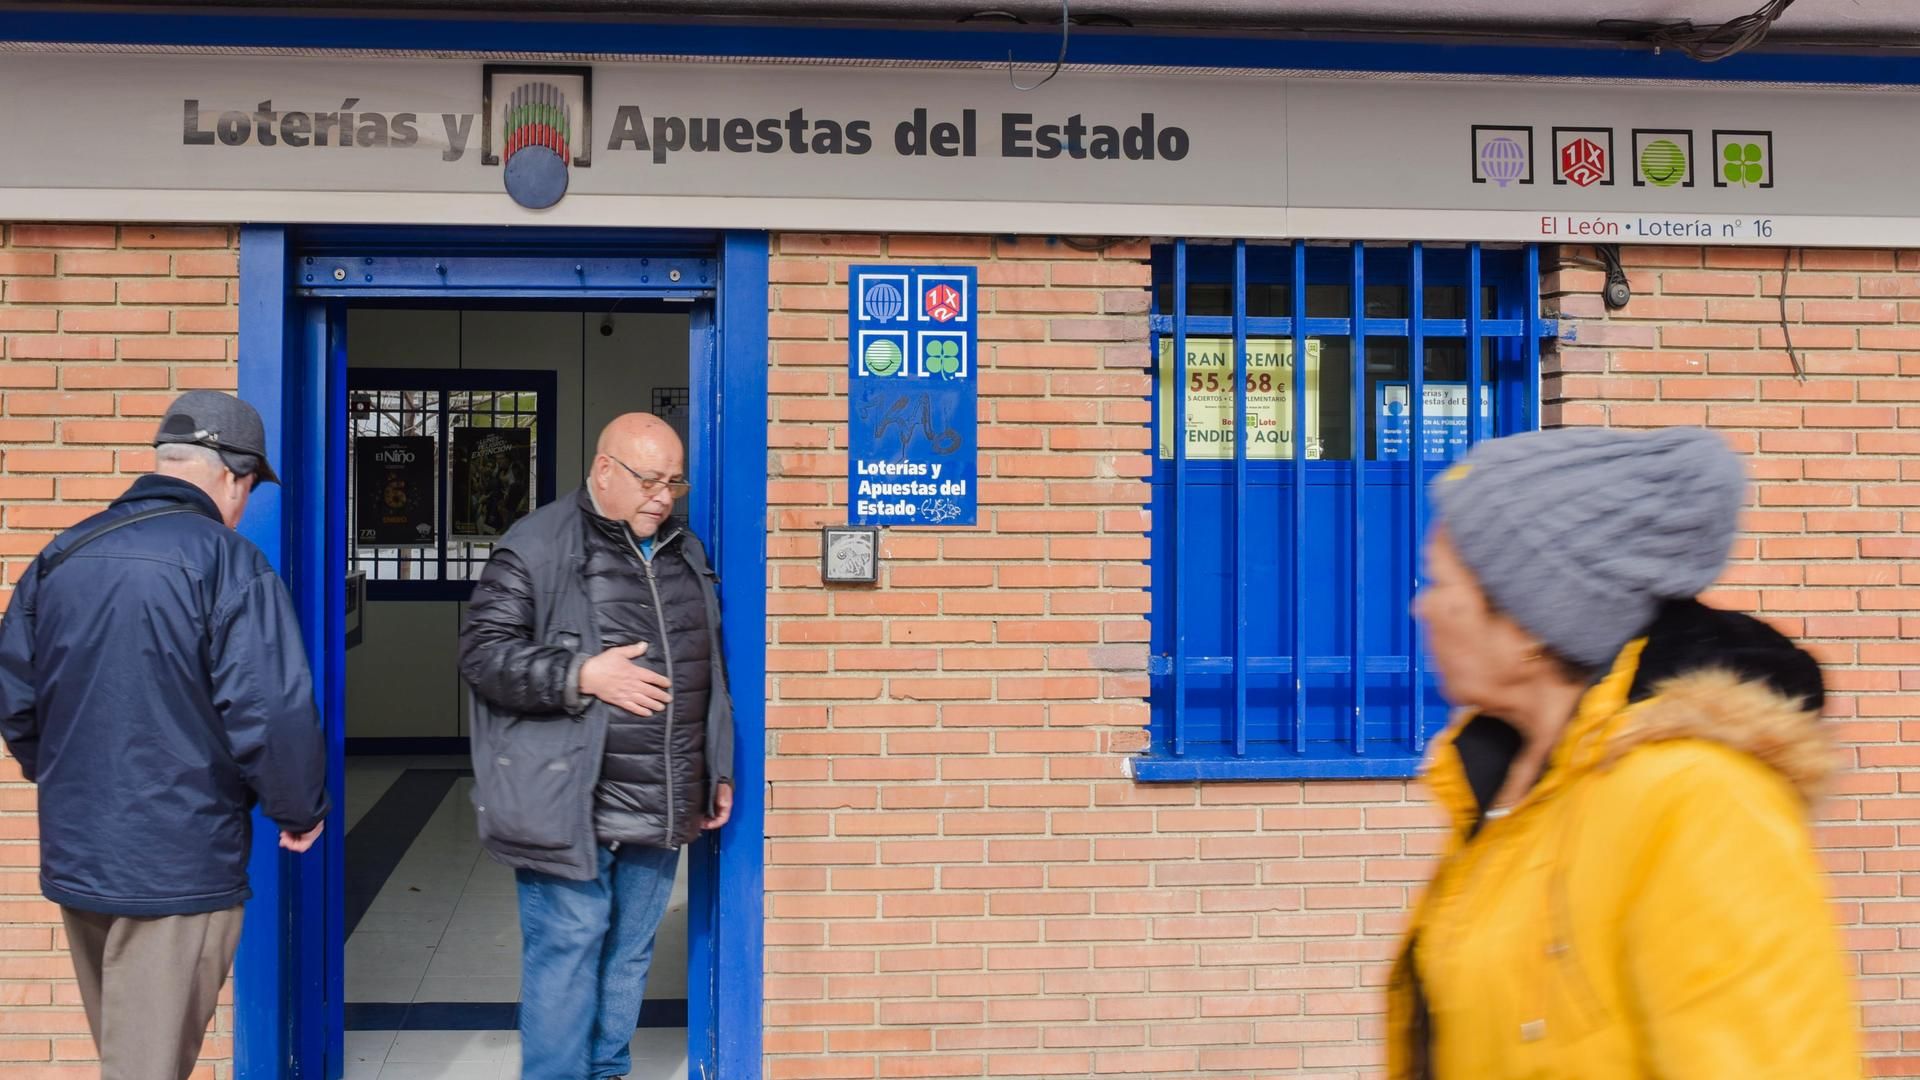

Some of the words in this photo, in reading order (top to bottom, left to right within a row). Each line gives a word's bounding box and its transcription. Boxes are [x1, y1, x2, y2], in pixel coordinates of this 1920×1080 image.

[183, 97, 419, 147] Loterías
[441, 113, 474, 162] y
[607, 105, 872, 165] Apuestas
[894, 107, 977, 157] del
[1001, 111, 1190, 161] Estado
[1541, 216, 1557, 235] El
[1568, 217, 1619, 236] León
[1638, 217, 1712, 238] Lotería
[1753, 219, 1773, 238] 16
[1186, 352, 1225, 367] RAN
[1245, 352, 1294, 367] REMI
[1259, 418, 1277, 426] Loto
[1185, 429, 1248, 443] ENDID
[1254, 430, 1293, 443] AQU
[857, 459, 927, 476] Loterías
[931, 463, 942, 480] y
[857, 480, 937, 499] Apuestas
[940, 480, 966, 496] del
[857, 500, 916, 516] Estado
